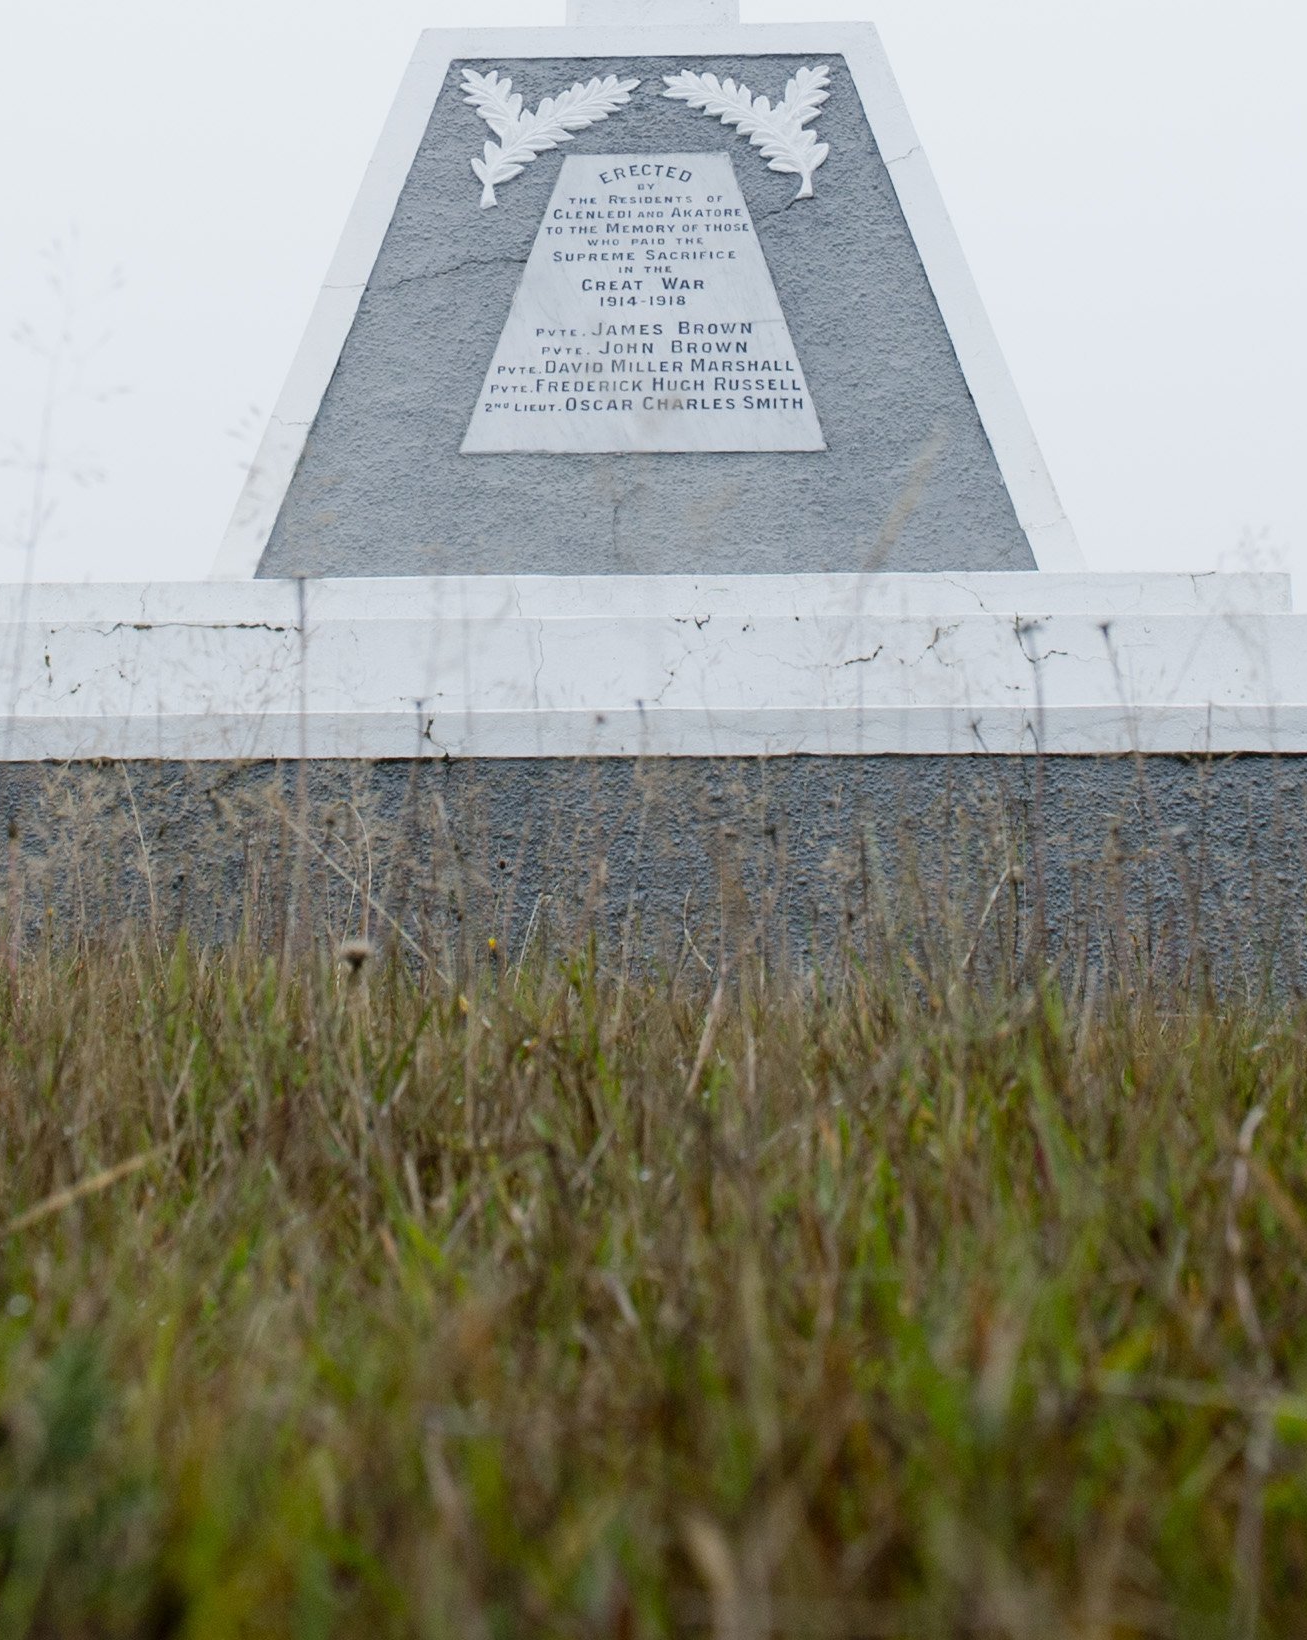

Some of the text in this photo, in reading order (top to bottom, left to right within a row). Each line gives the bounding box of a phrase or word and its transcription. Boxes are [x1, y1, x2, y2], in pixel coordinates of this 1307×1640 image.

[599, 163, 693, 185] ERECTED
[637, 183, 655, 191] BY
[569, 195, 723, 205] THE RESIDENTS OF
[553, 207, 742, 220] GLENLEDI AND AKATORE
[546, 223, 750, 235] TO THE MEMORY OF THOSE
[587, 237, 704, 246] WHO PAID THE
[553, 249, 737, 262] SUPREME SACRIFICE
[618, 265, 672, 274] IN THE
[581, 277, 705, 292] GREAT WAR
[600, 295, 687, 307] 1914-1918
[591, 322, 663, 336] JAMES
[678, 321, 753, 335] BROWN
[598, 341, 654, 355] JOHN
[671, 340, 748, 354] BROWN
[545, 360, 603, 374] DAVID
[611, 359, 683, 373] MILLER
[690, 358, 794, 372] MARSHALL
[536, 378, 643, 393] FREDERICK
[652, 377, 705, 392] HUGH
[714, 376, 801, 391] RUSSELL
[565, 397, 633, 412] OSCAR
[643, 396, 736, 411] CHARLES
[743, 395, 804, 410] SMITH
